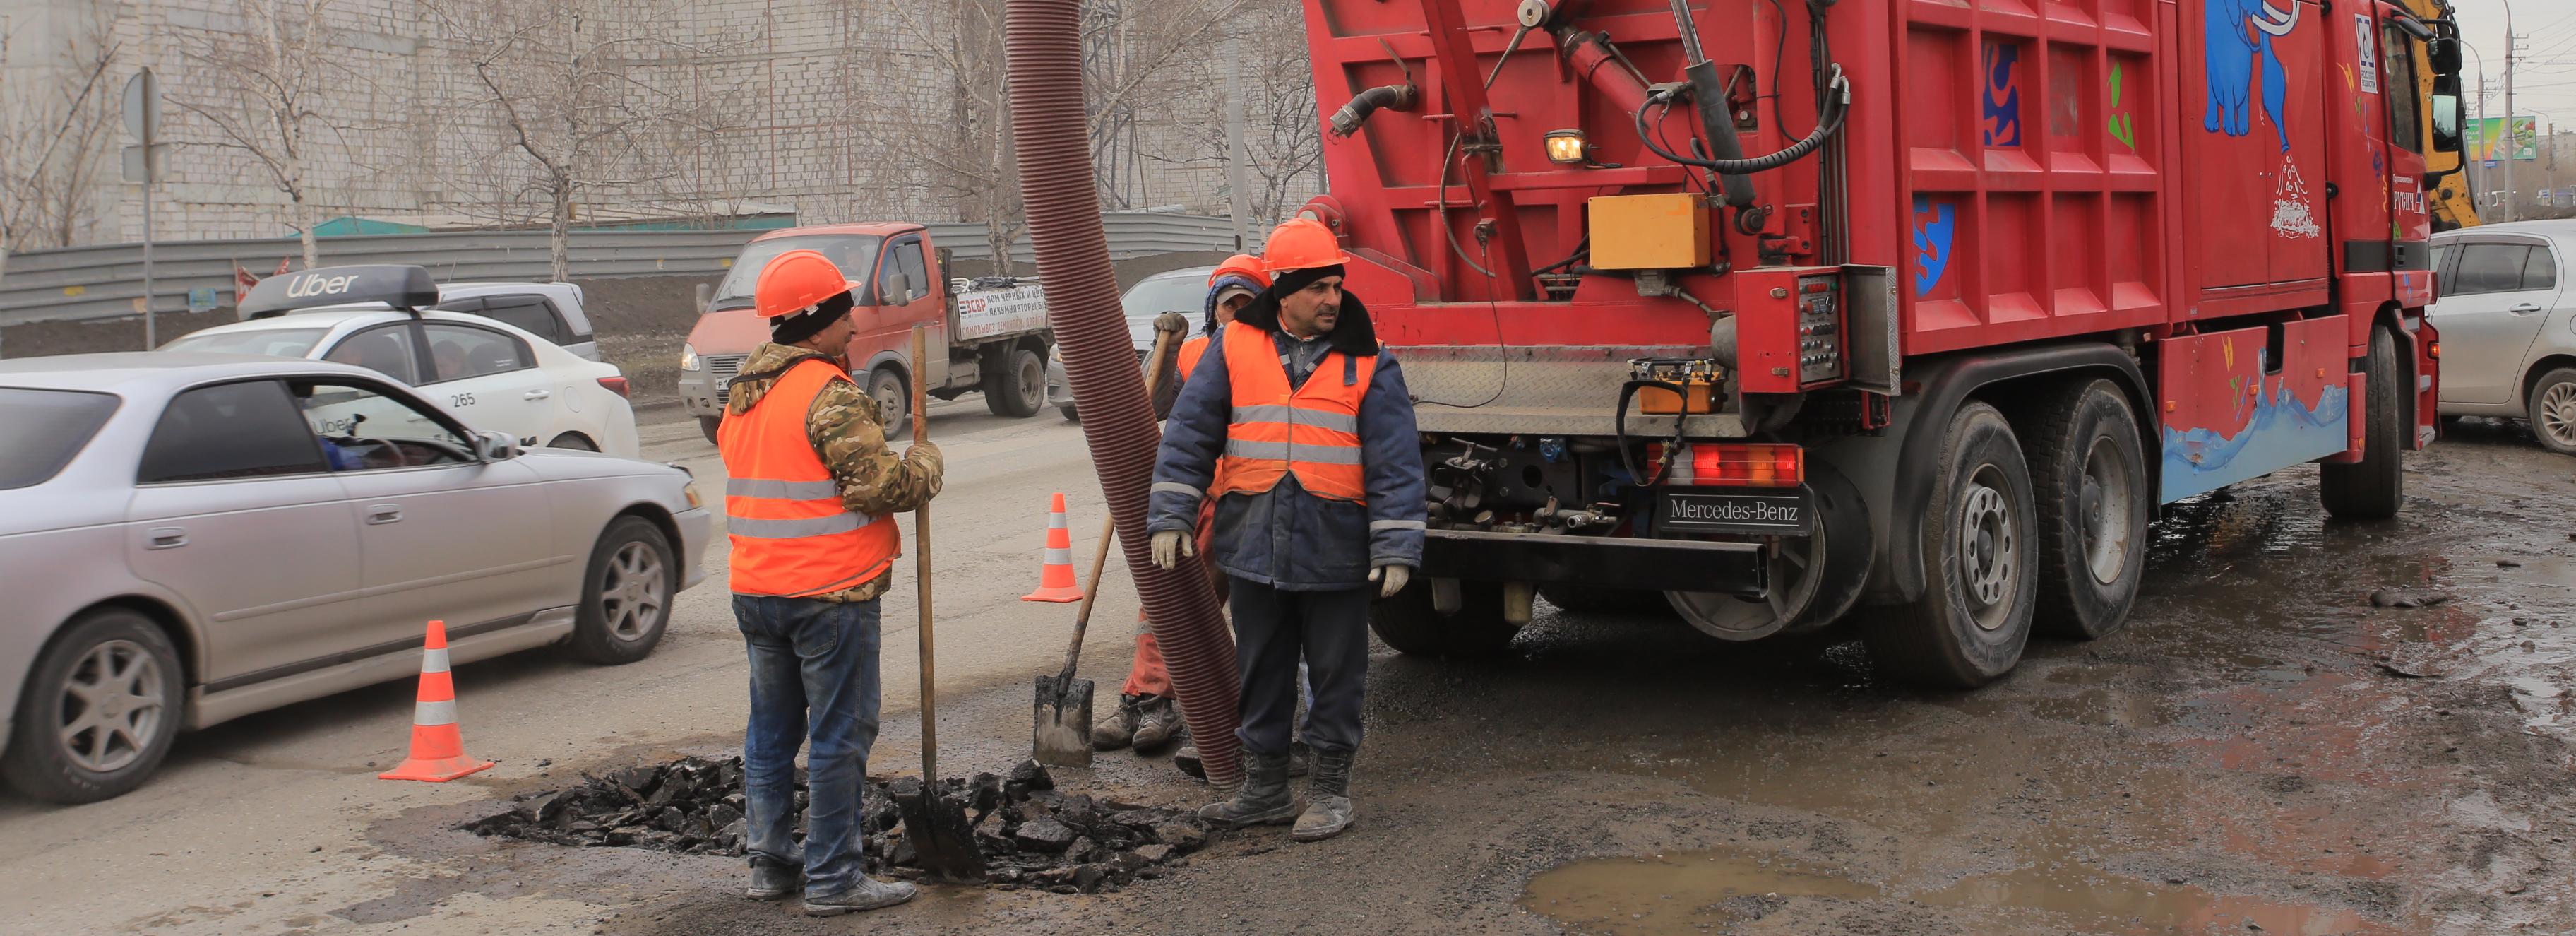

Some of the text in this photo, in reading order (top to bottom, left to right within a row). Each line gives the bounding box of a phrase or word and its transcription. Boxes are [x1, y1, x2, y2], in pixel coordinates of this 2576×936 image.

[2394, 191, 2414, 216] РУСИЧ
[286, 273, 359, 298] Uber
[989, 303, 1037, 316] АККУМУЛЯТОРЫ
[451, 392, 476, 408] 265
[312, 417, 351, 434] Uber
[1670, 499, 1798, 521] Mercedes-Benz
